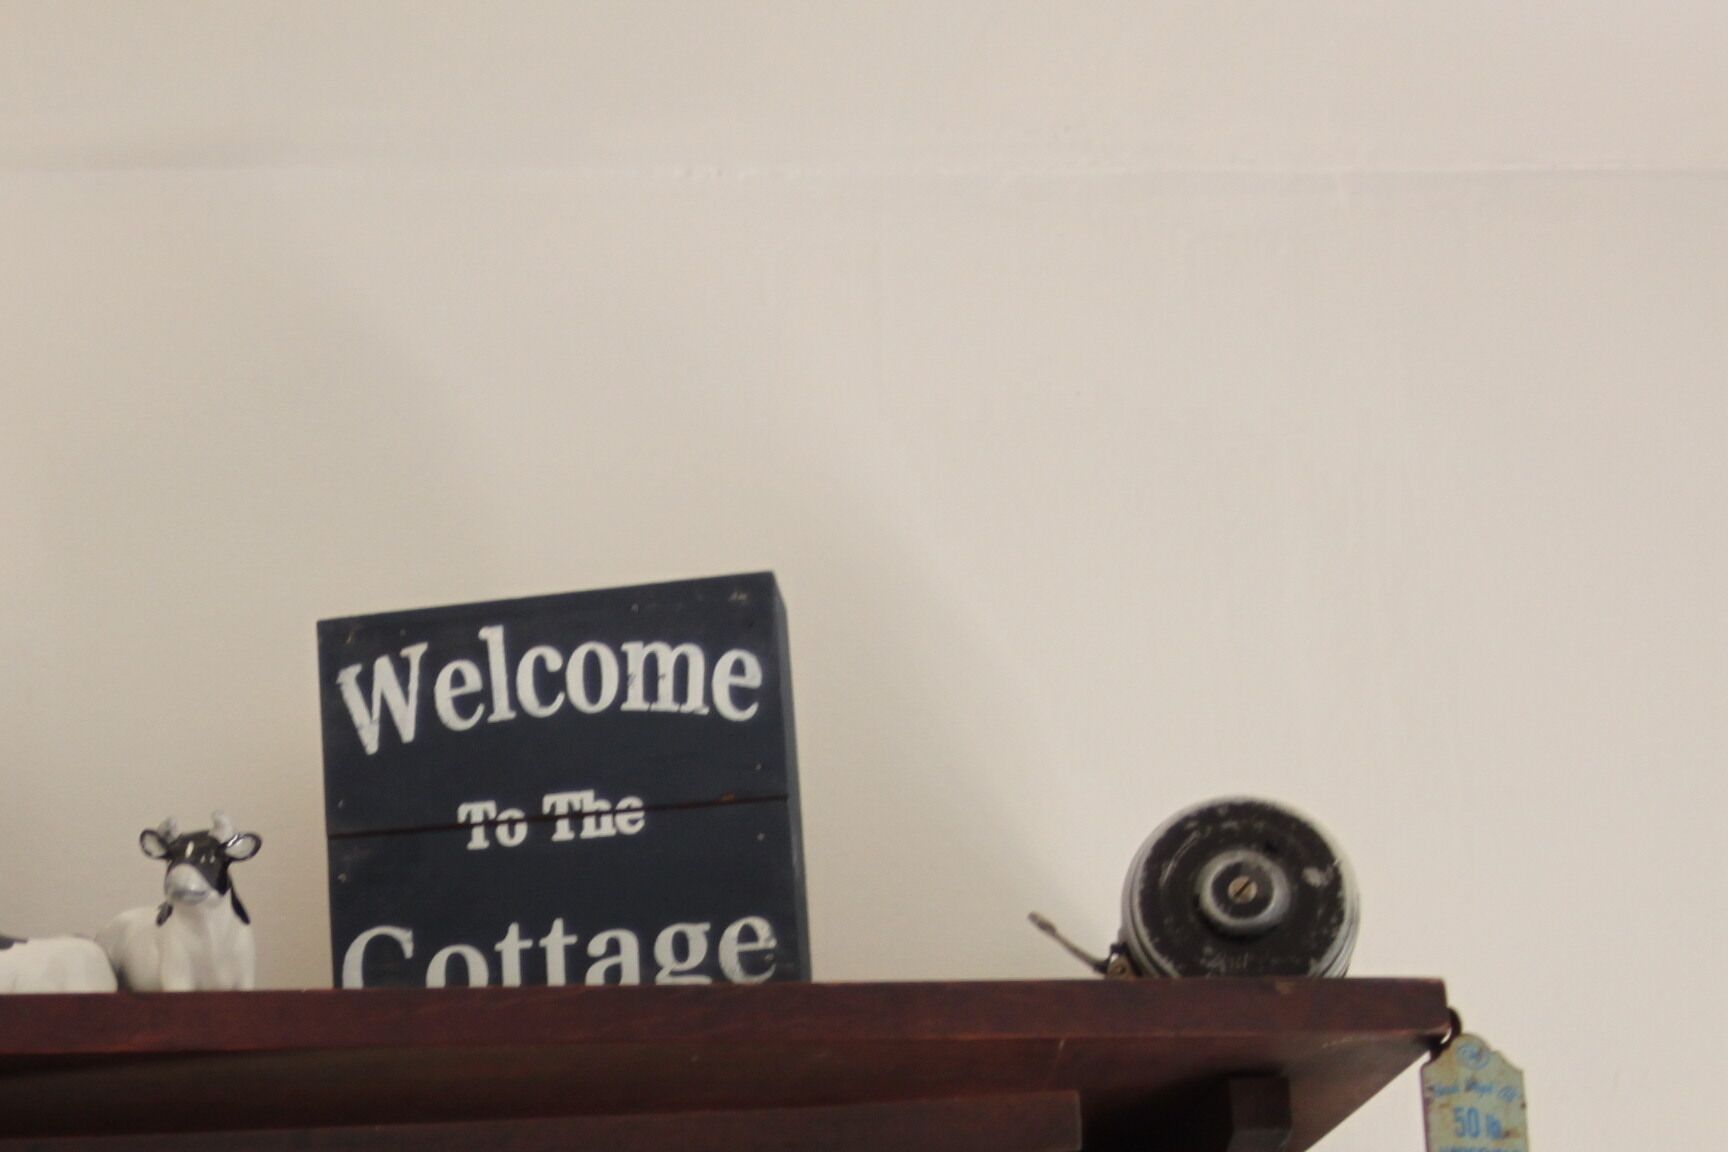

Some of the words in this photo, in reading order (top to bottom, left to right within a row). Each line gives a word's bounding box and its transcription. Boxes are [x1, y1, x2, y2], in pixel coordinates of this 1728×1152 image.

[336, 624, 763, 755] Welcome
[457, 800, 528, 850] To
[542, 789, 646, 842] The
[341, 915, 777, 988] Cottage
